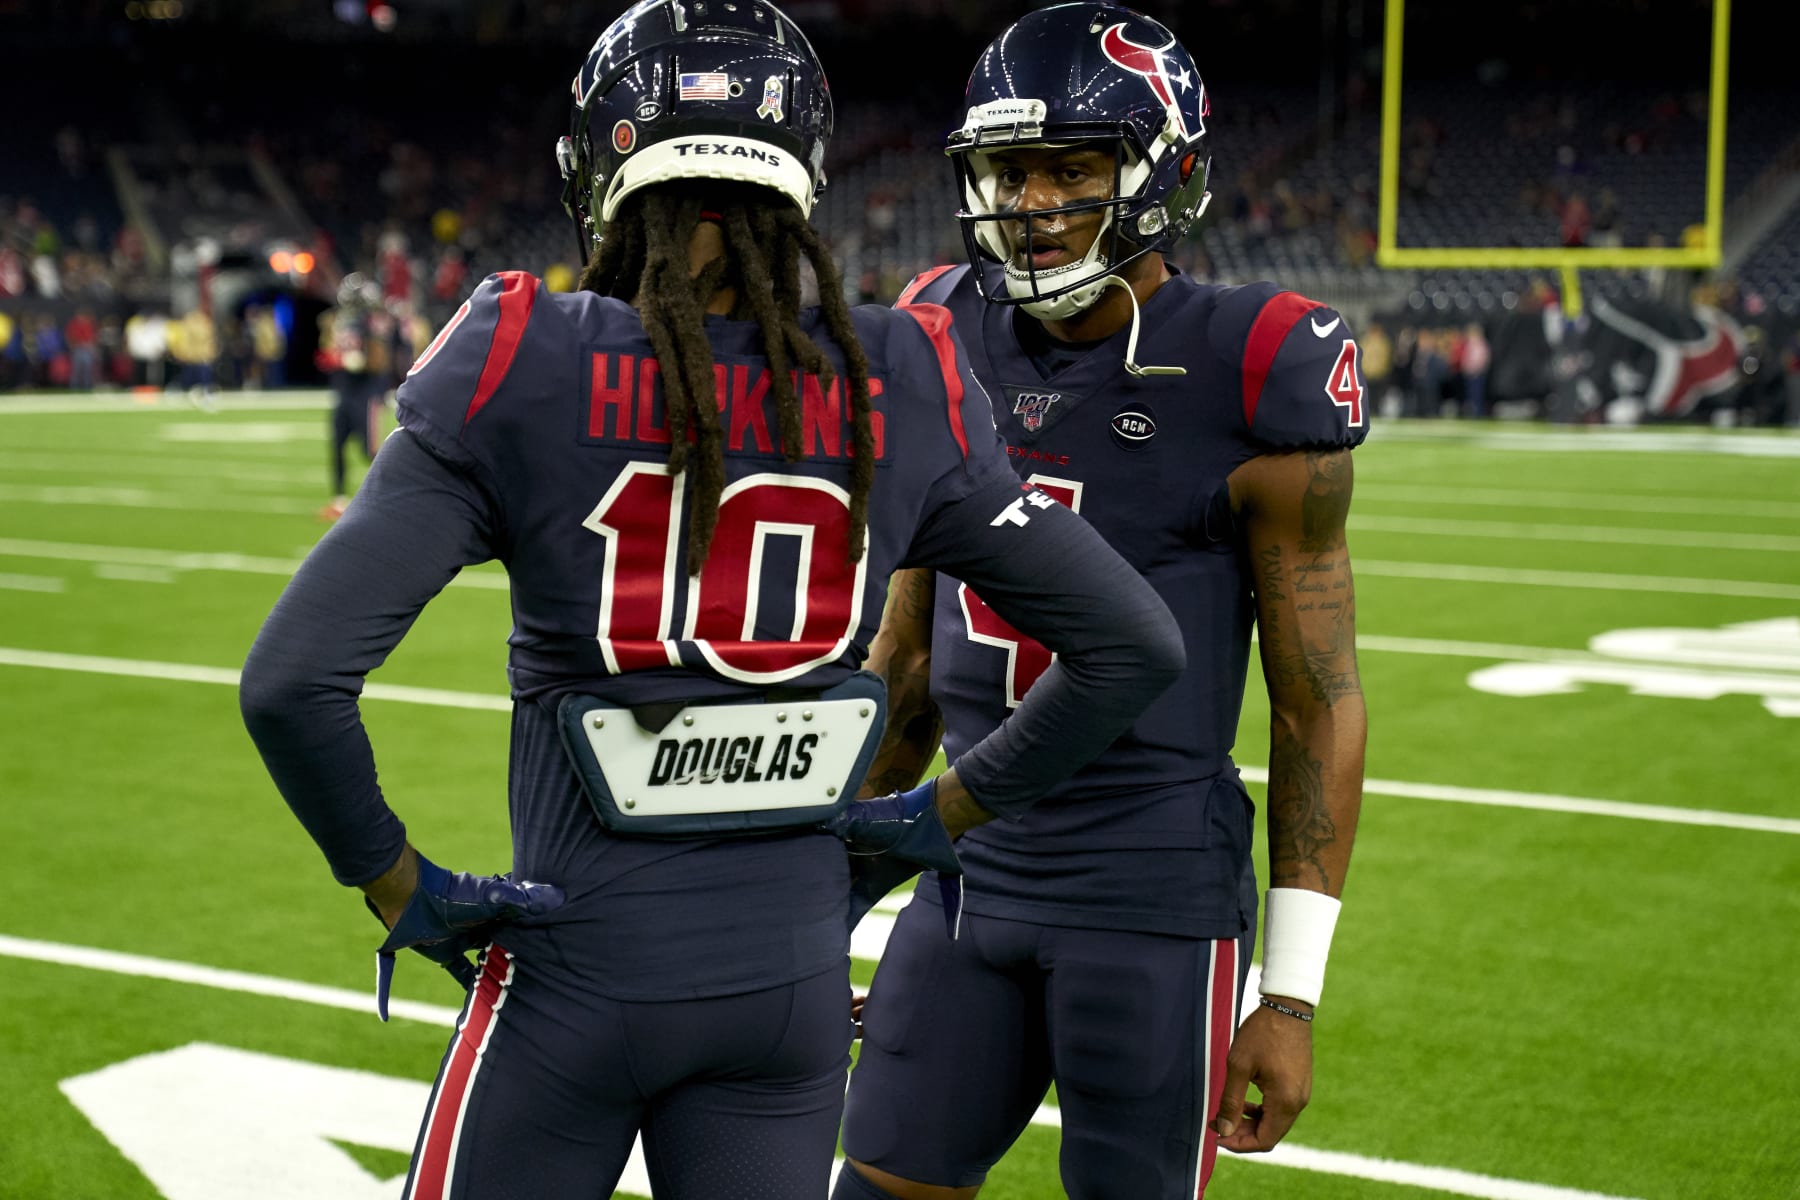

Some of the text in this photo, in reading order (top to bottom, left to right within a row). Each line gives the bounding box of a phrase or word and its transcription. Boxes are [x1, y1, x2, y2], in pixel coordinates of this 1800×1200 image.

[640, 105, 656, 117] RCM
[987, 108, 1024, 117] TEXANS
[673, 143, 781, 167] TEXANS
[1324, 339, 1364, 427] 4
[588, 351, 886, 460] HOKNS
[1121, 418, 1147, 434] RCM
[1005, 446, 1070, 465] EXANS
[582, 461, 869, 684] 10
[647, 733, 819, 787] DOUGLAS
